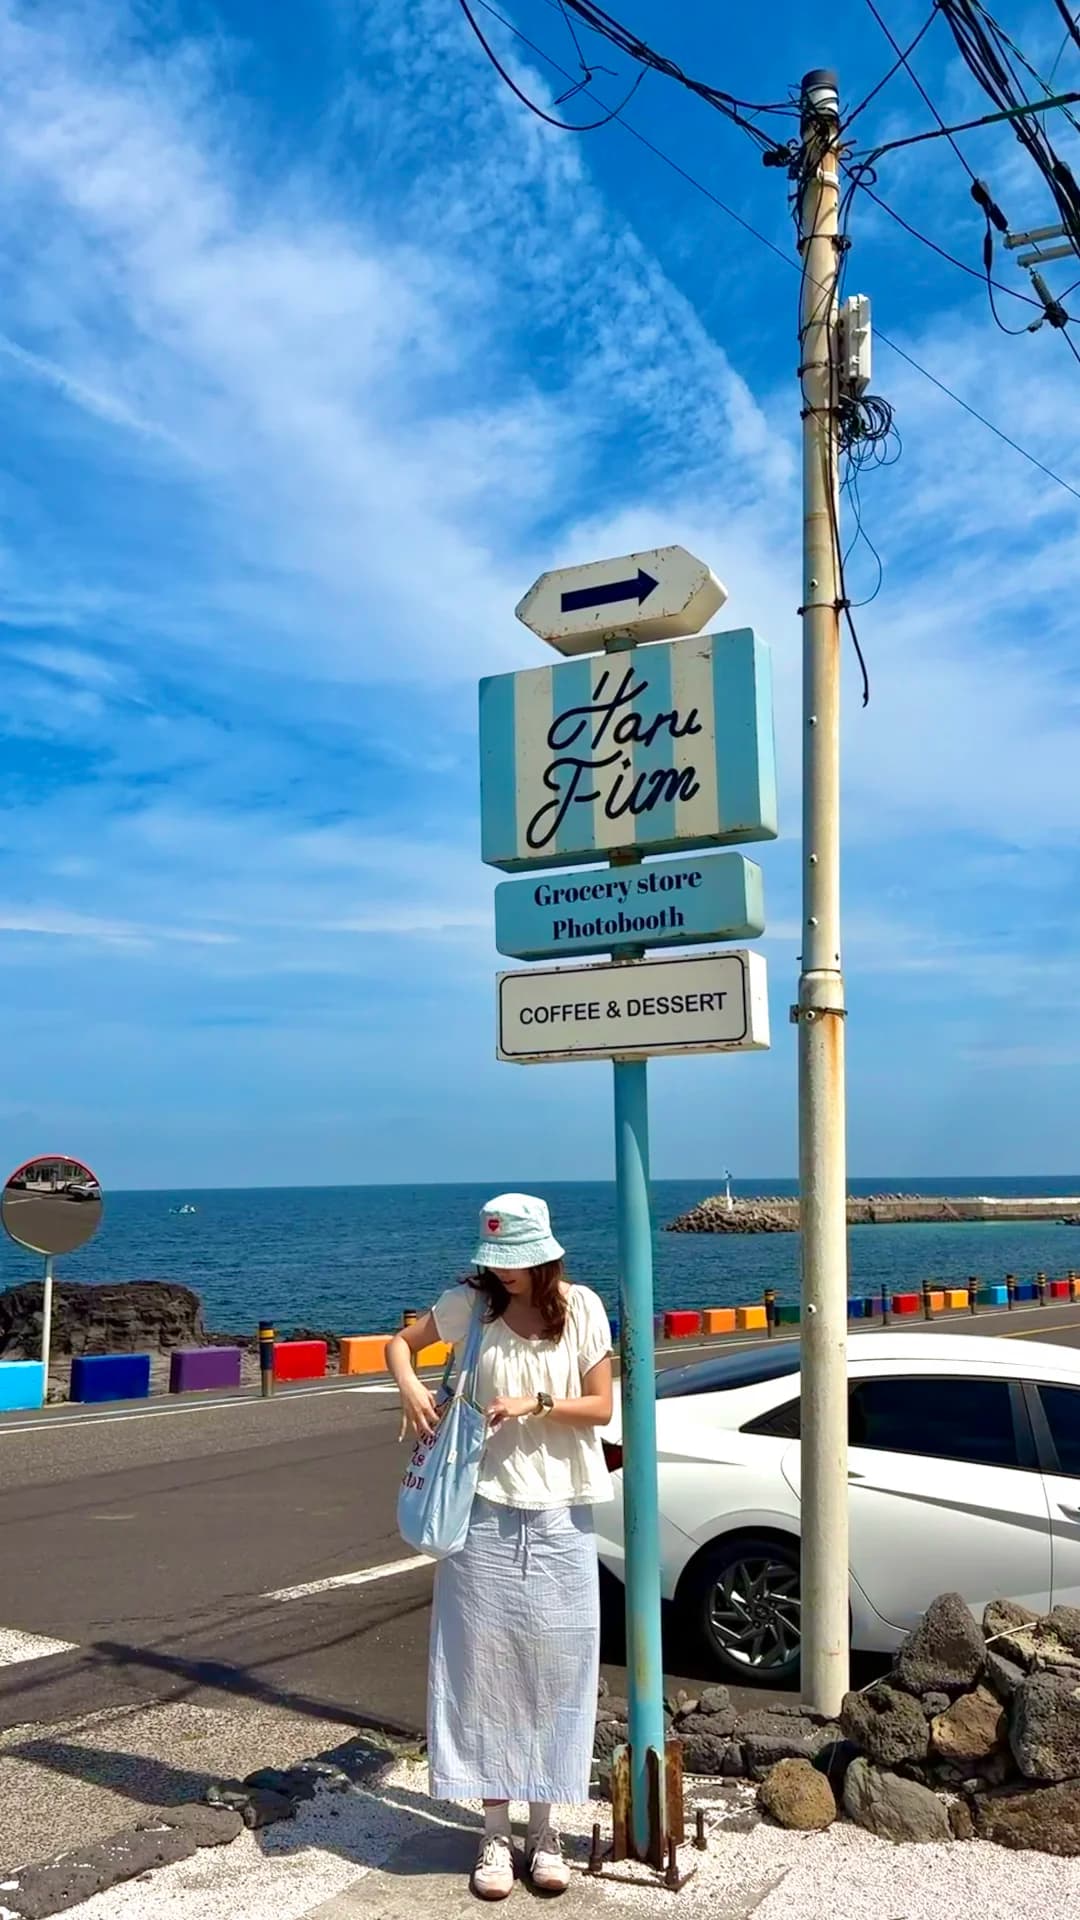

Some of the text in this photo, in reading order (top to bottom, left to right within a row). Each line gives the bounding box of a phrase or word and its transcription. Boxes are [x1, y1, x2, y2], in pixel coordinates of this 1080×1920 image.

[547, 666, 702, 750] Haru
[534, 871, 703, 906] Grocery store
[553, 906, 685, 940] Photobooth
[519, 992, 728, 1024] COFFEE & DESSERT
